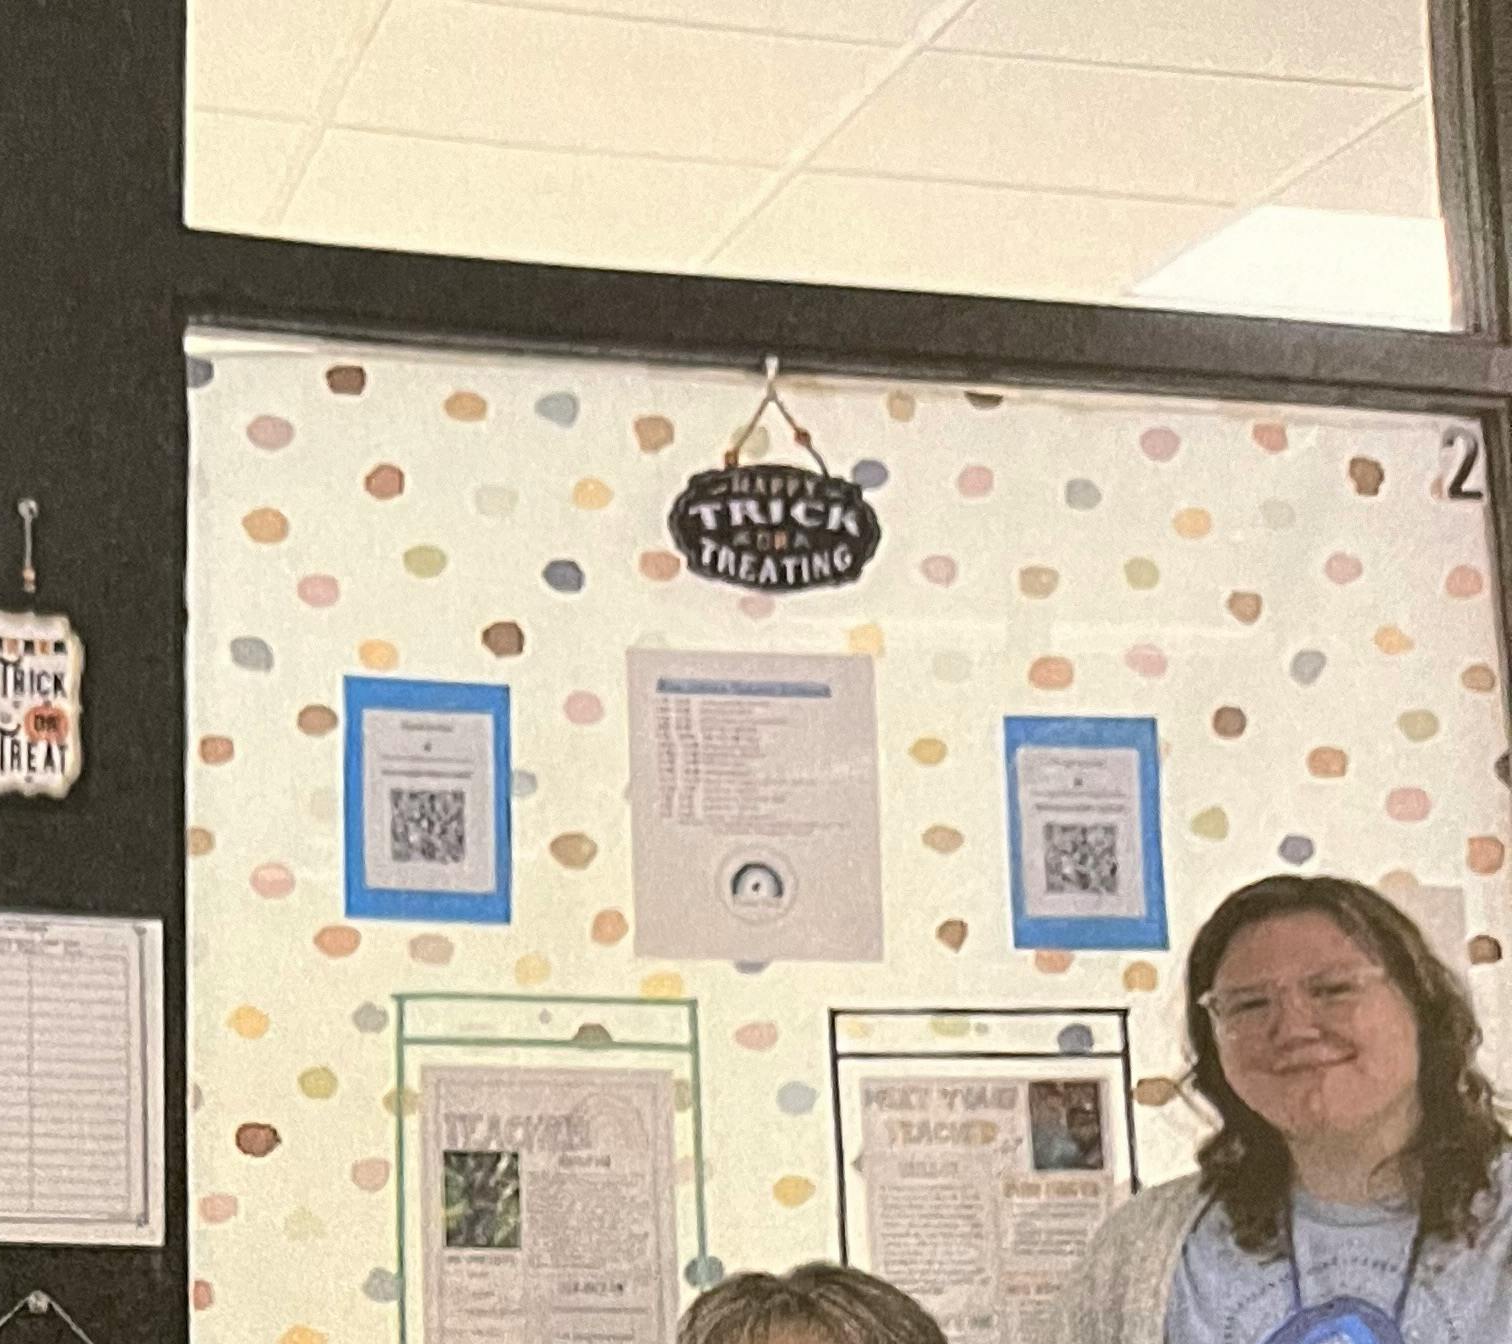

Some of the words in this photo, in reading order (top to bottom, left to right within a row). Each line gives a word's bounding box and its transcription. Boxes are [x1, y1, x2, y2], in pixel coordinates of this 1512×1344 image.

[1442, 425, 1484, 500] 2
[688, 498, 861, 538] TRICK
[700, 536, 853, 586] TREATING
